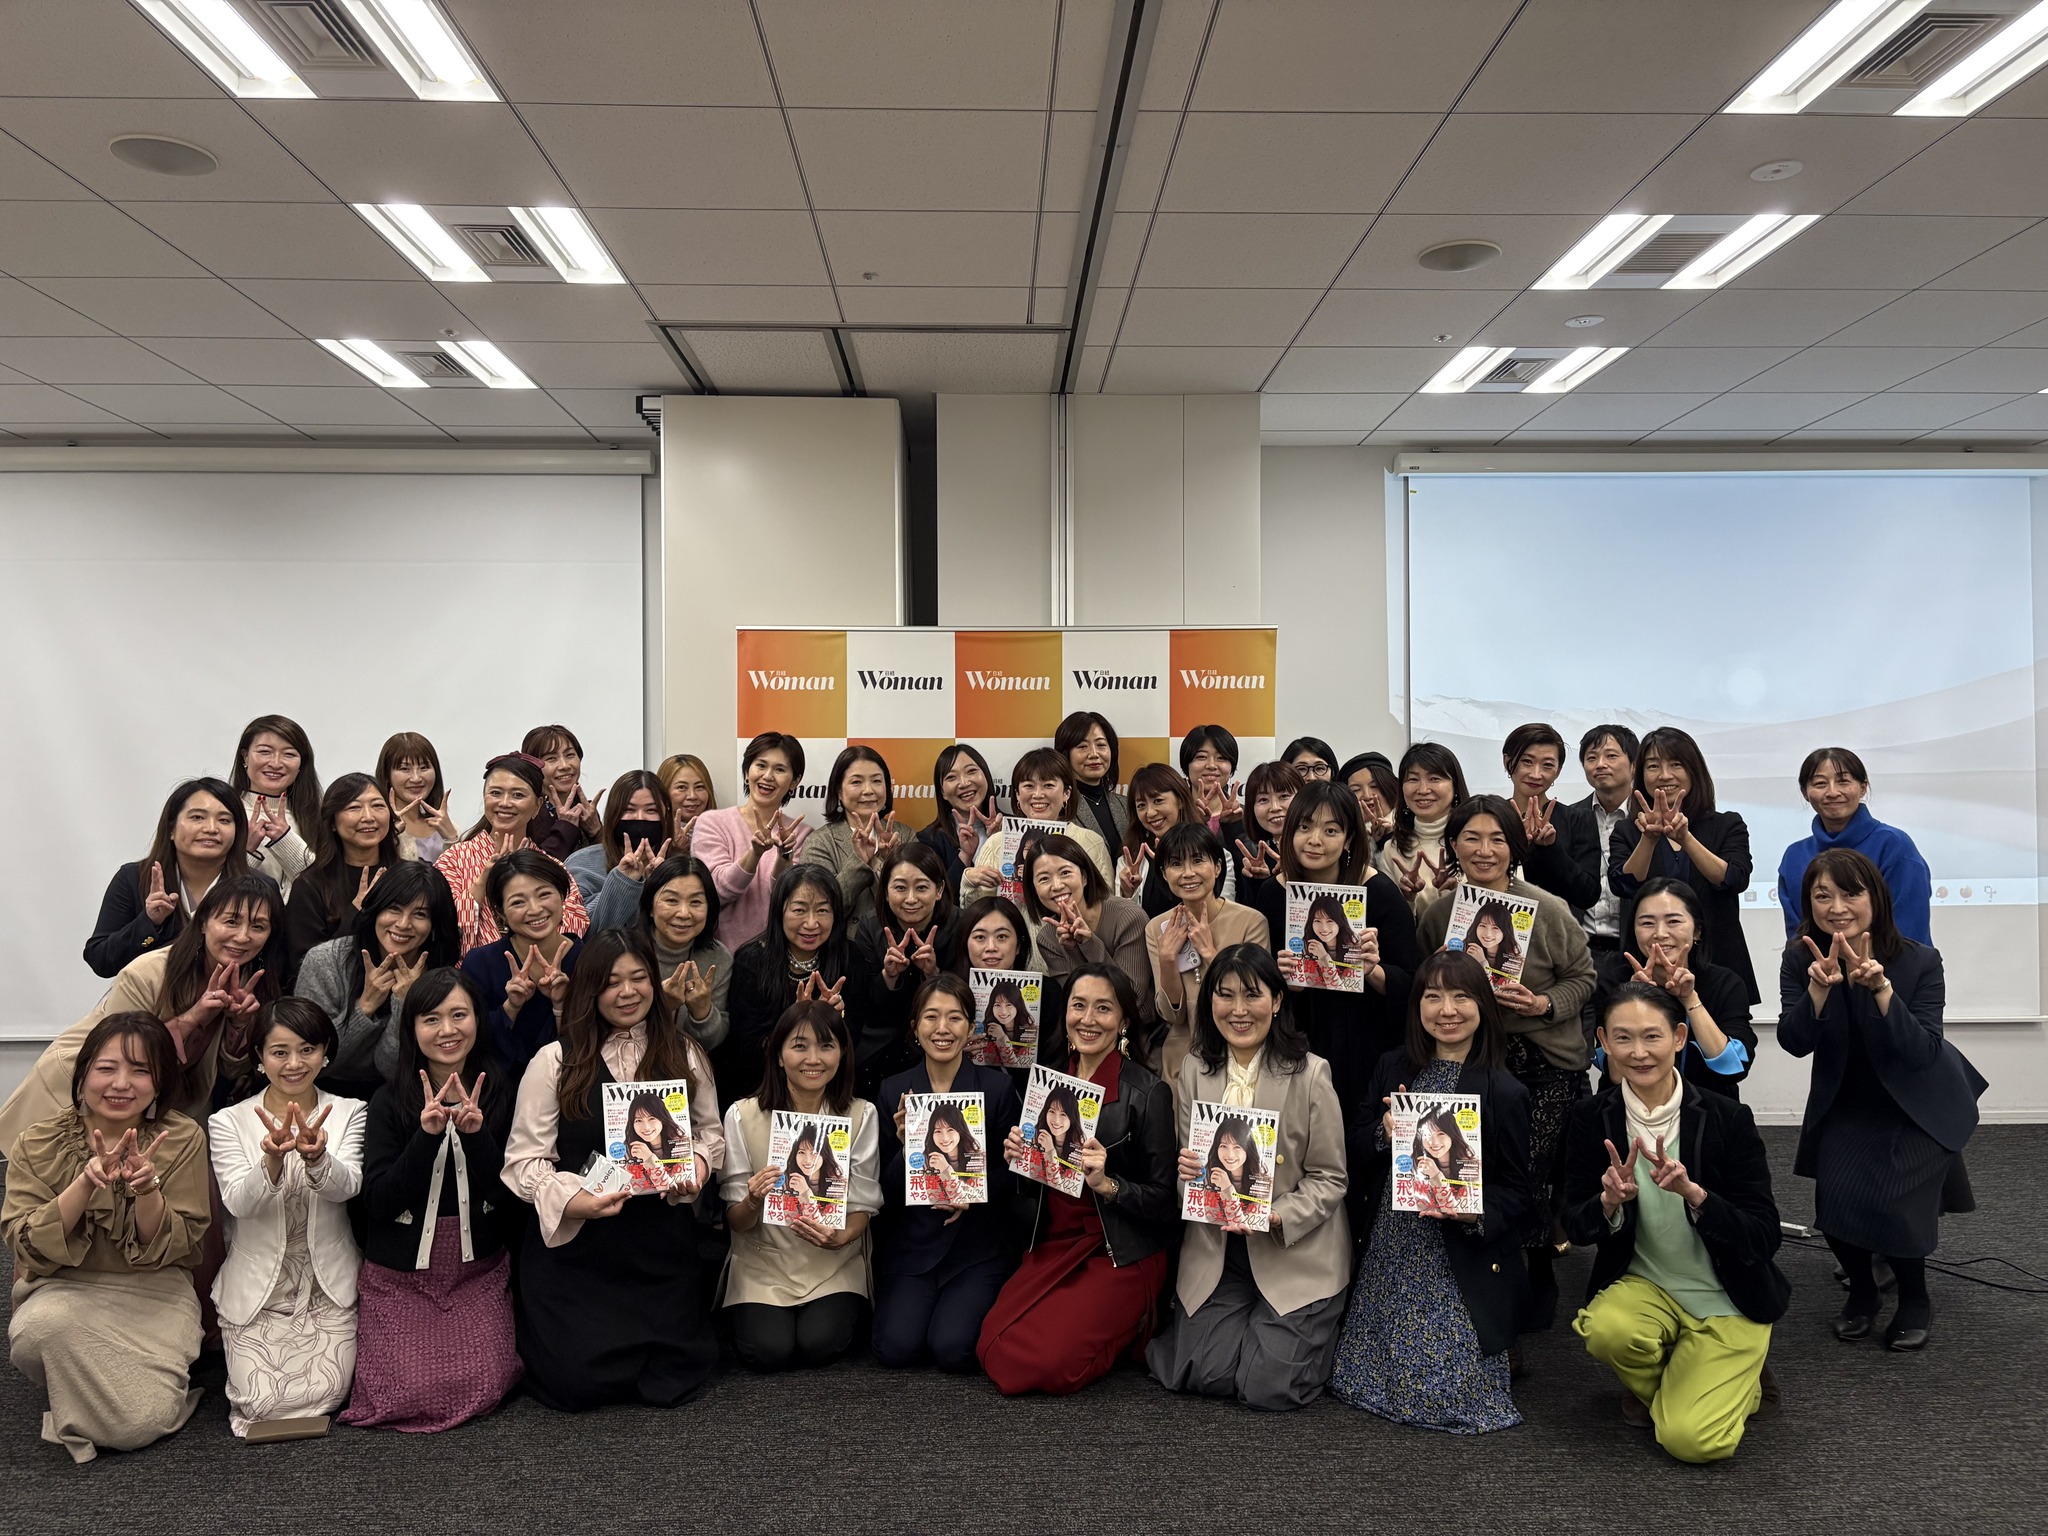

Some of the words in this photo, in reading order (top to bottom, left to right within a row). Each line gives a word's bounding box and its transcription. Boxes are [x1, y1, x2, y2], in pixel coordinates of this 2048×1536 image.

[747, 670, 835, 690] Woman
[857, 671, 943, 690] Woman
[964, 671, 1051, 690] Woman
[1072, 670, 1158, 690] Woman
[1179, 669, 1266, 689] Woman
[1339, 978, 1361, 988] 2026
[601, 1166, 616, 1183] voicy
[621, 1162, 692, 1179] 躍するために
[1058, 1178, 1080, 1192] 2026
[768, 1194, 843, 1214] 飛躍するために
[1187, 1188, 1268, 1215] 飛躍するために
[820, 1215, 842, 1225] 2026
[1242, 1213, 1266, 1226] 2026
